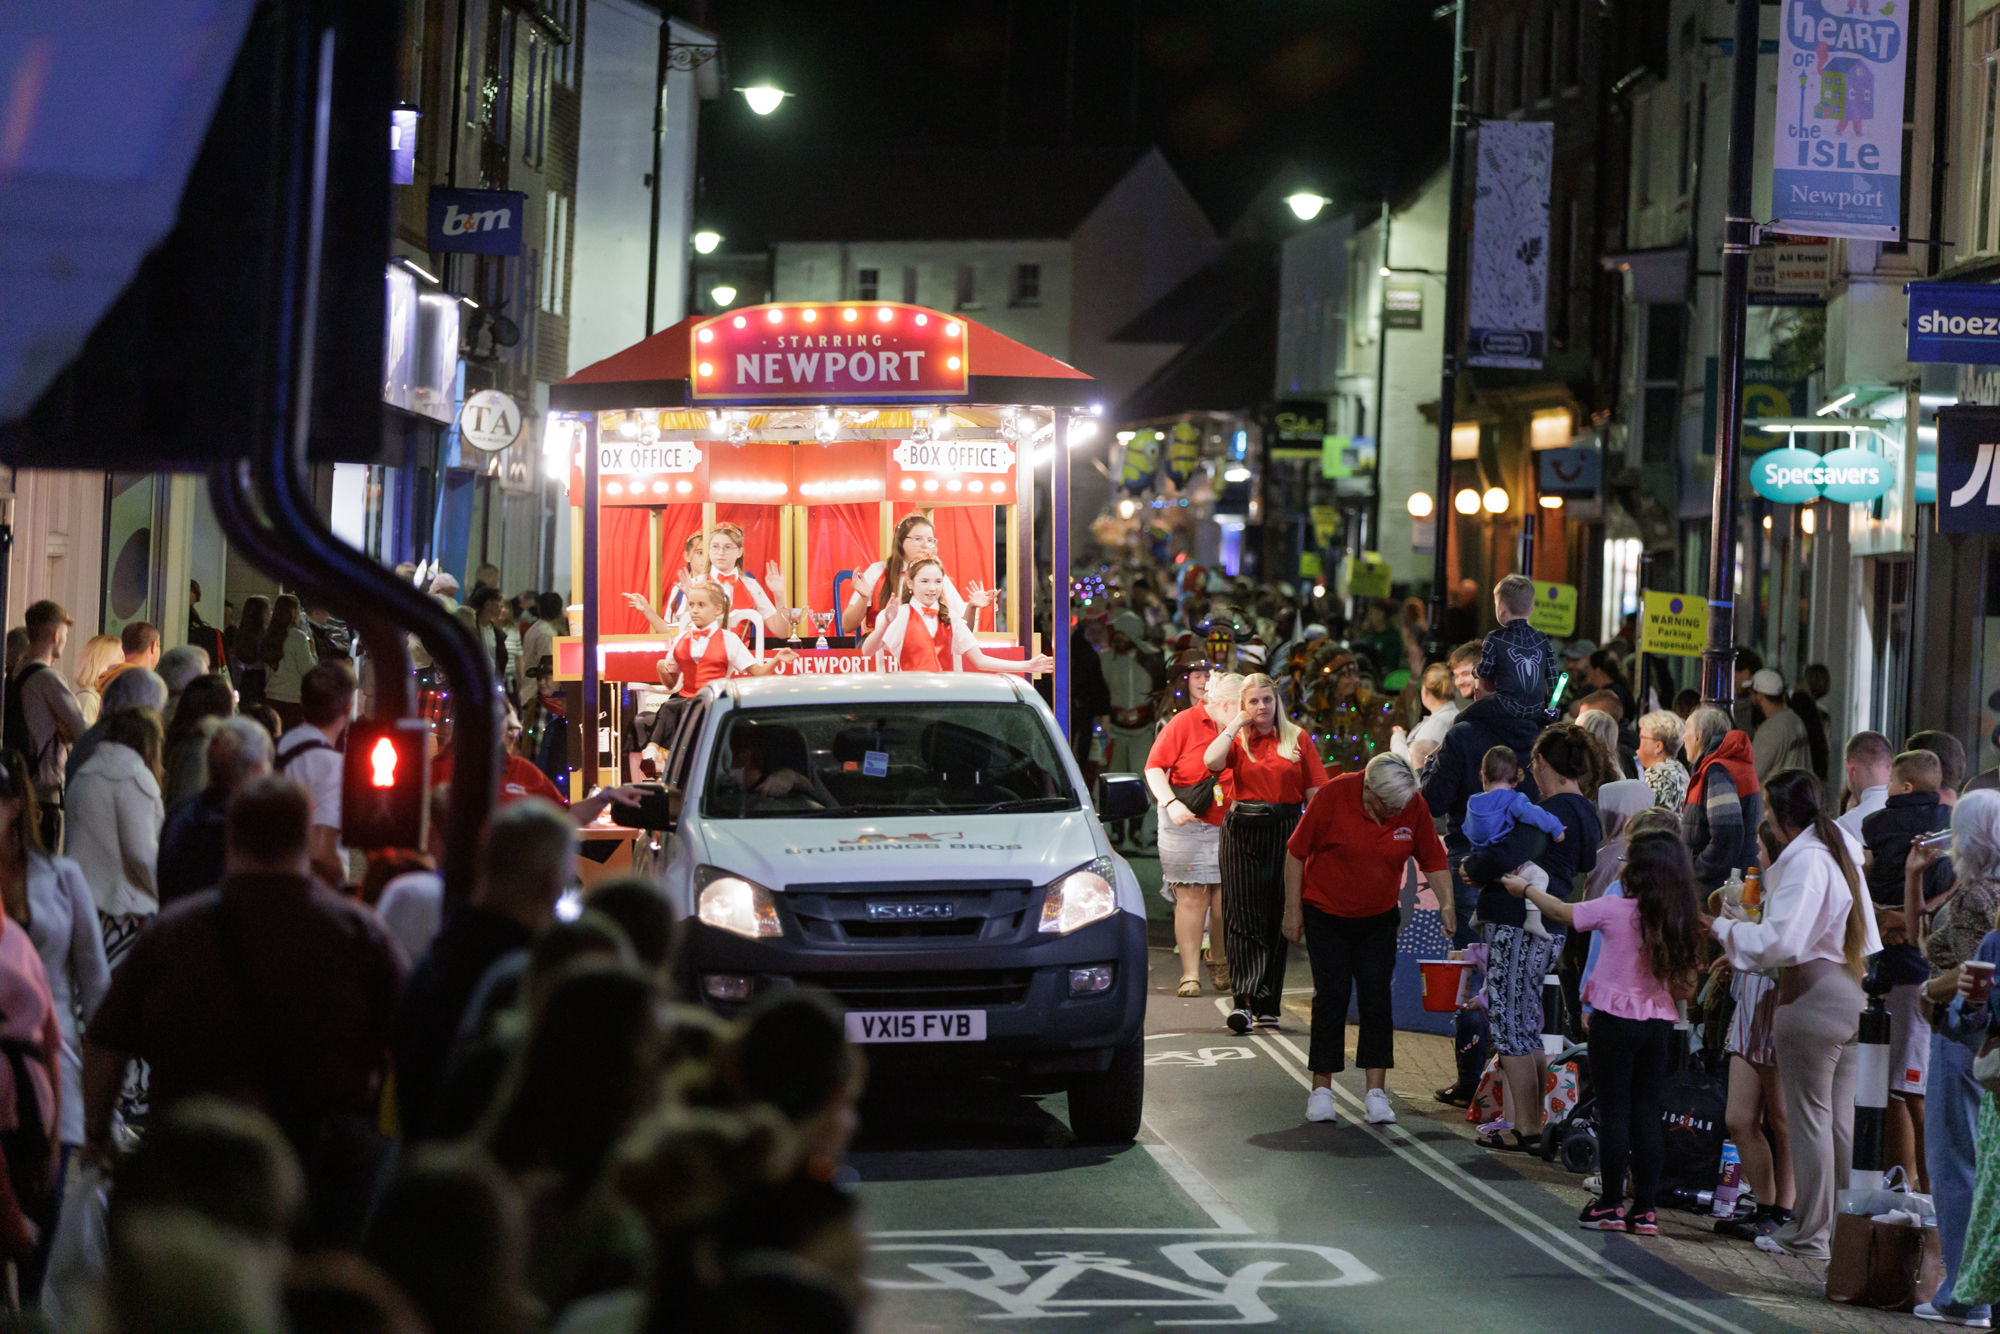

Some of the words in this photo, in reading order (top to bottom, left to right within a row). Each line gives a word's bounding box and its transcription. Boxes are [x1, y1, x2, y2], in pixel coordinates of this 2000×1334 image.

[1791, 185, 1884, 210] Newport
[442, 205, 511, 236] b&m
[1917, 309, 2000, 335] shoez
[777, 334, 882, 348] STARRING
[736, 351, 925, 384] NEWPORT
[469, 405, 513, 436] TA
[601, 448, 622, 468] OX
[631, 448, 682, 468] OFFICE
[910, 445, 941, 466] BOX
[948, 447, 997, 467] OFFICE
[1764, 463, 1880, 489] Specsavers
[1950, 443, 2000, 507] J
[1651, 614, 1700, 629] WARNING
[1657, 626, 1692, 640] Parking
[793, 656, 871, 674] NEWPORT
[785, 842, 941, 855] STUBBINGS
[950, 843, 1023, 851] BROS
[868, 904, 951, 919] ISUZU
[862, 1014, 915, 1039] VX15
[922, 1013, 971, 1038] FVB
